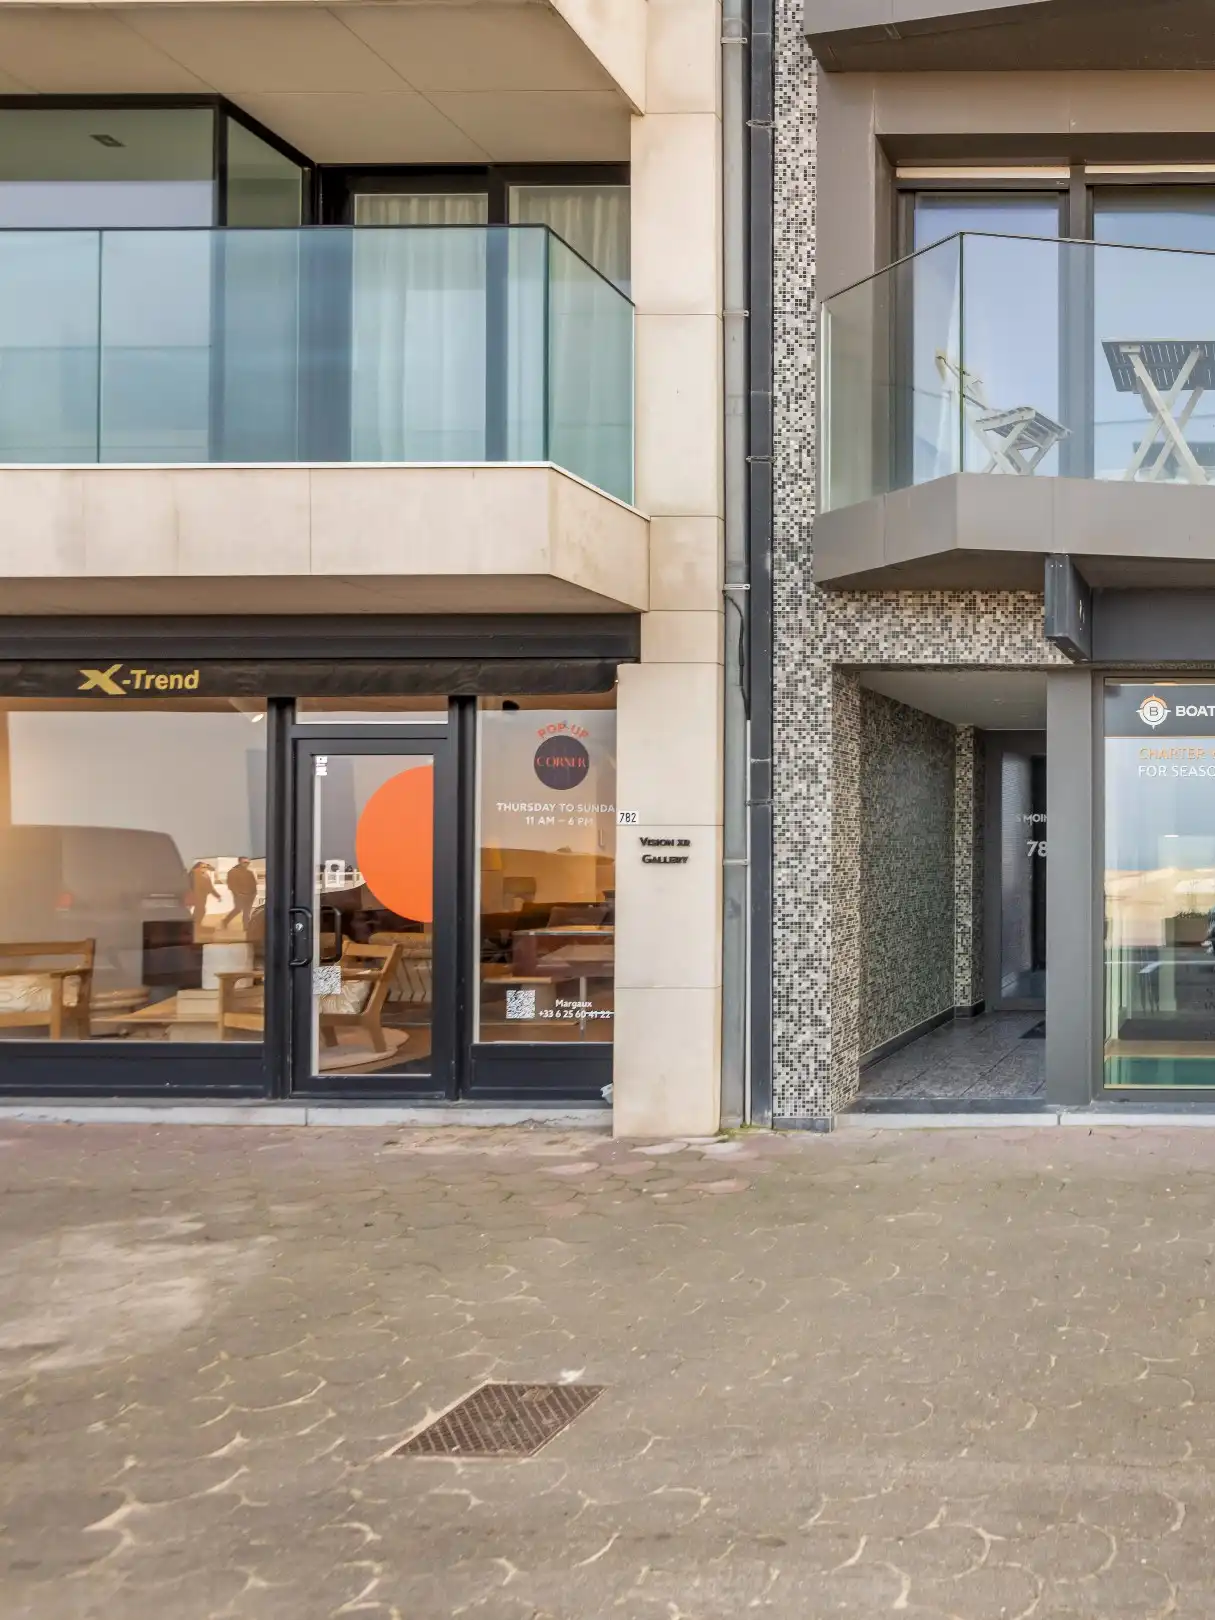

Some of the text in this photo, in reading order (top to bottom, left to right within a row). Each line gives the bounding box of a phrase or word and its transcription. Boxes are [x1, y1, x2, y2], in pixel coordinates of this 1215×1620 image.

[77, 663, 200, 695] X-Trend
[1139, 748, 1206, 760] CHARTER
[536, 756, 587, 769] CORNER
[1138, 765, 1168, 777] FOR
[496, 802, 616, 813] THURSDAY TO SUNDA
[525, 817, 535, 825] 11
[538, 816, 555, 826] AM
[568, 817, 574, 826] 6
[577, 817, 594, 826] PM
[619, 812, 637, 823] 782
[555, 999, 593, 1010] Margaux
[538, 1009, 554, 1018] +33
[555, 1009, 561, 1018] 6
[563, 1009, 573, 1018] 25
[575, 1009, 586, 1018] 60
[600, 1010, 611, 1018] 22
